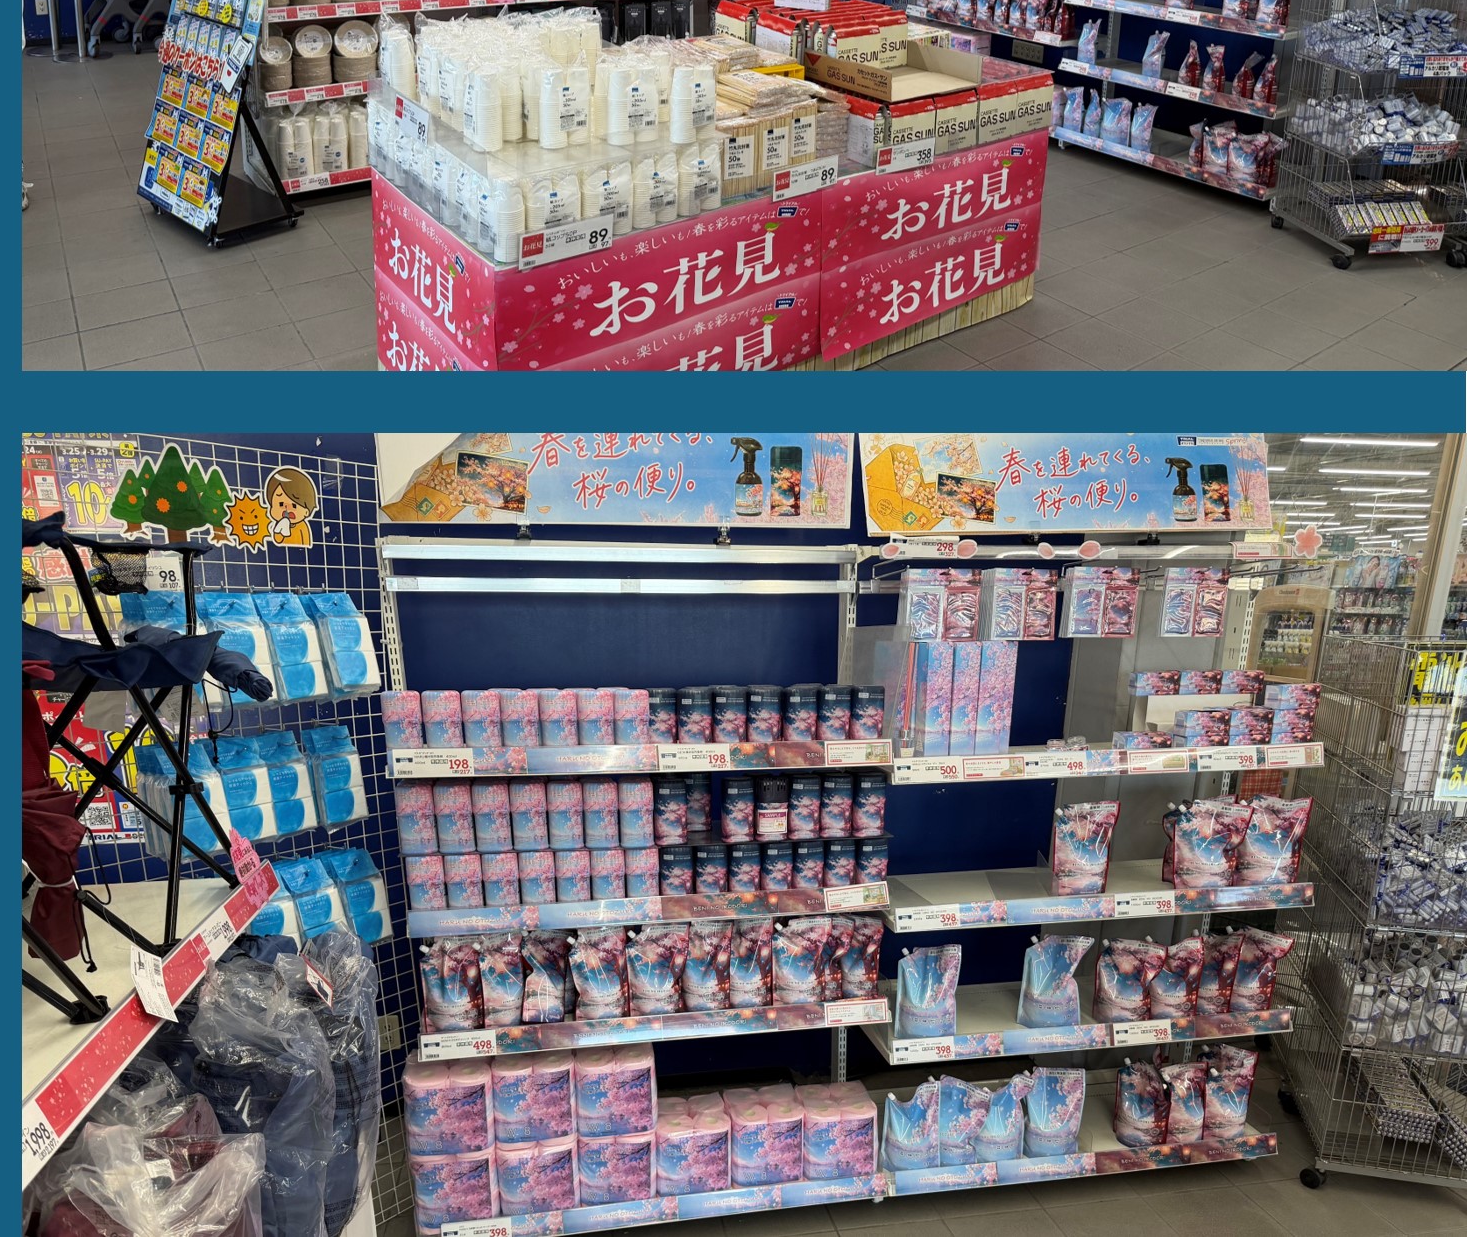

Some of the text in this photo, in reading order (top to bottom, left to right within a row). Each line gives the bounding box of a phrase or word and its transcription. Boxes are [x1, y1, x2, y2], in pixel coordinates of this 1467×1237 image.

[937, 118, 977, 138] GAS SUN
[588, 227, 609, 245] 89
[589, 231, 781, 337] お花見
[571, 461, 696, 511] 桜の便り。
[159, 570, 177, 583] 98
[1238, 754, 1256, 765] 398
[473, 1040, 493, 1051] 498
